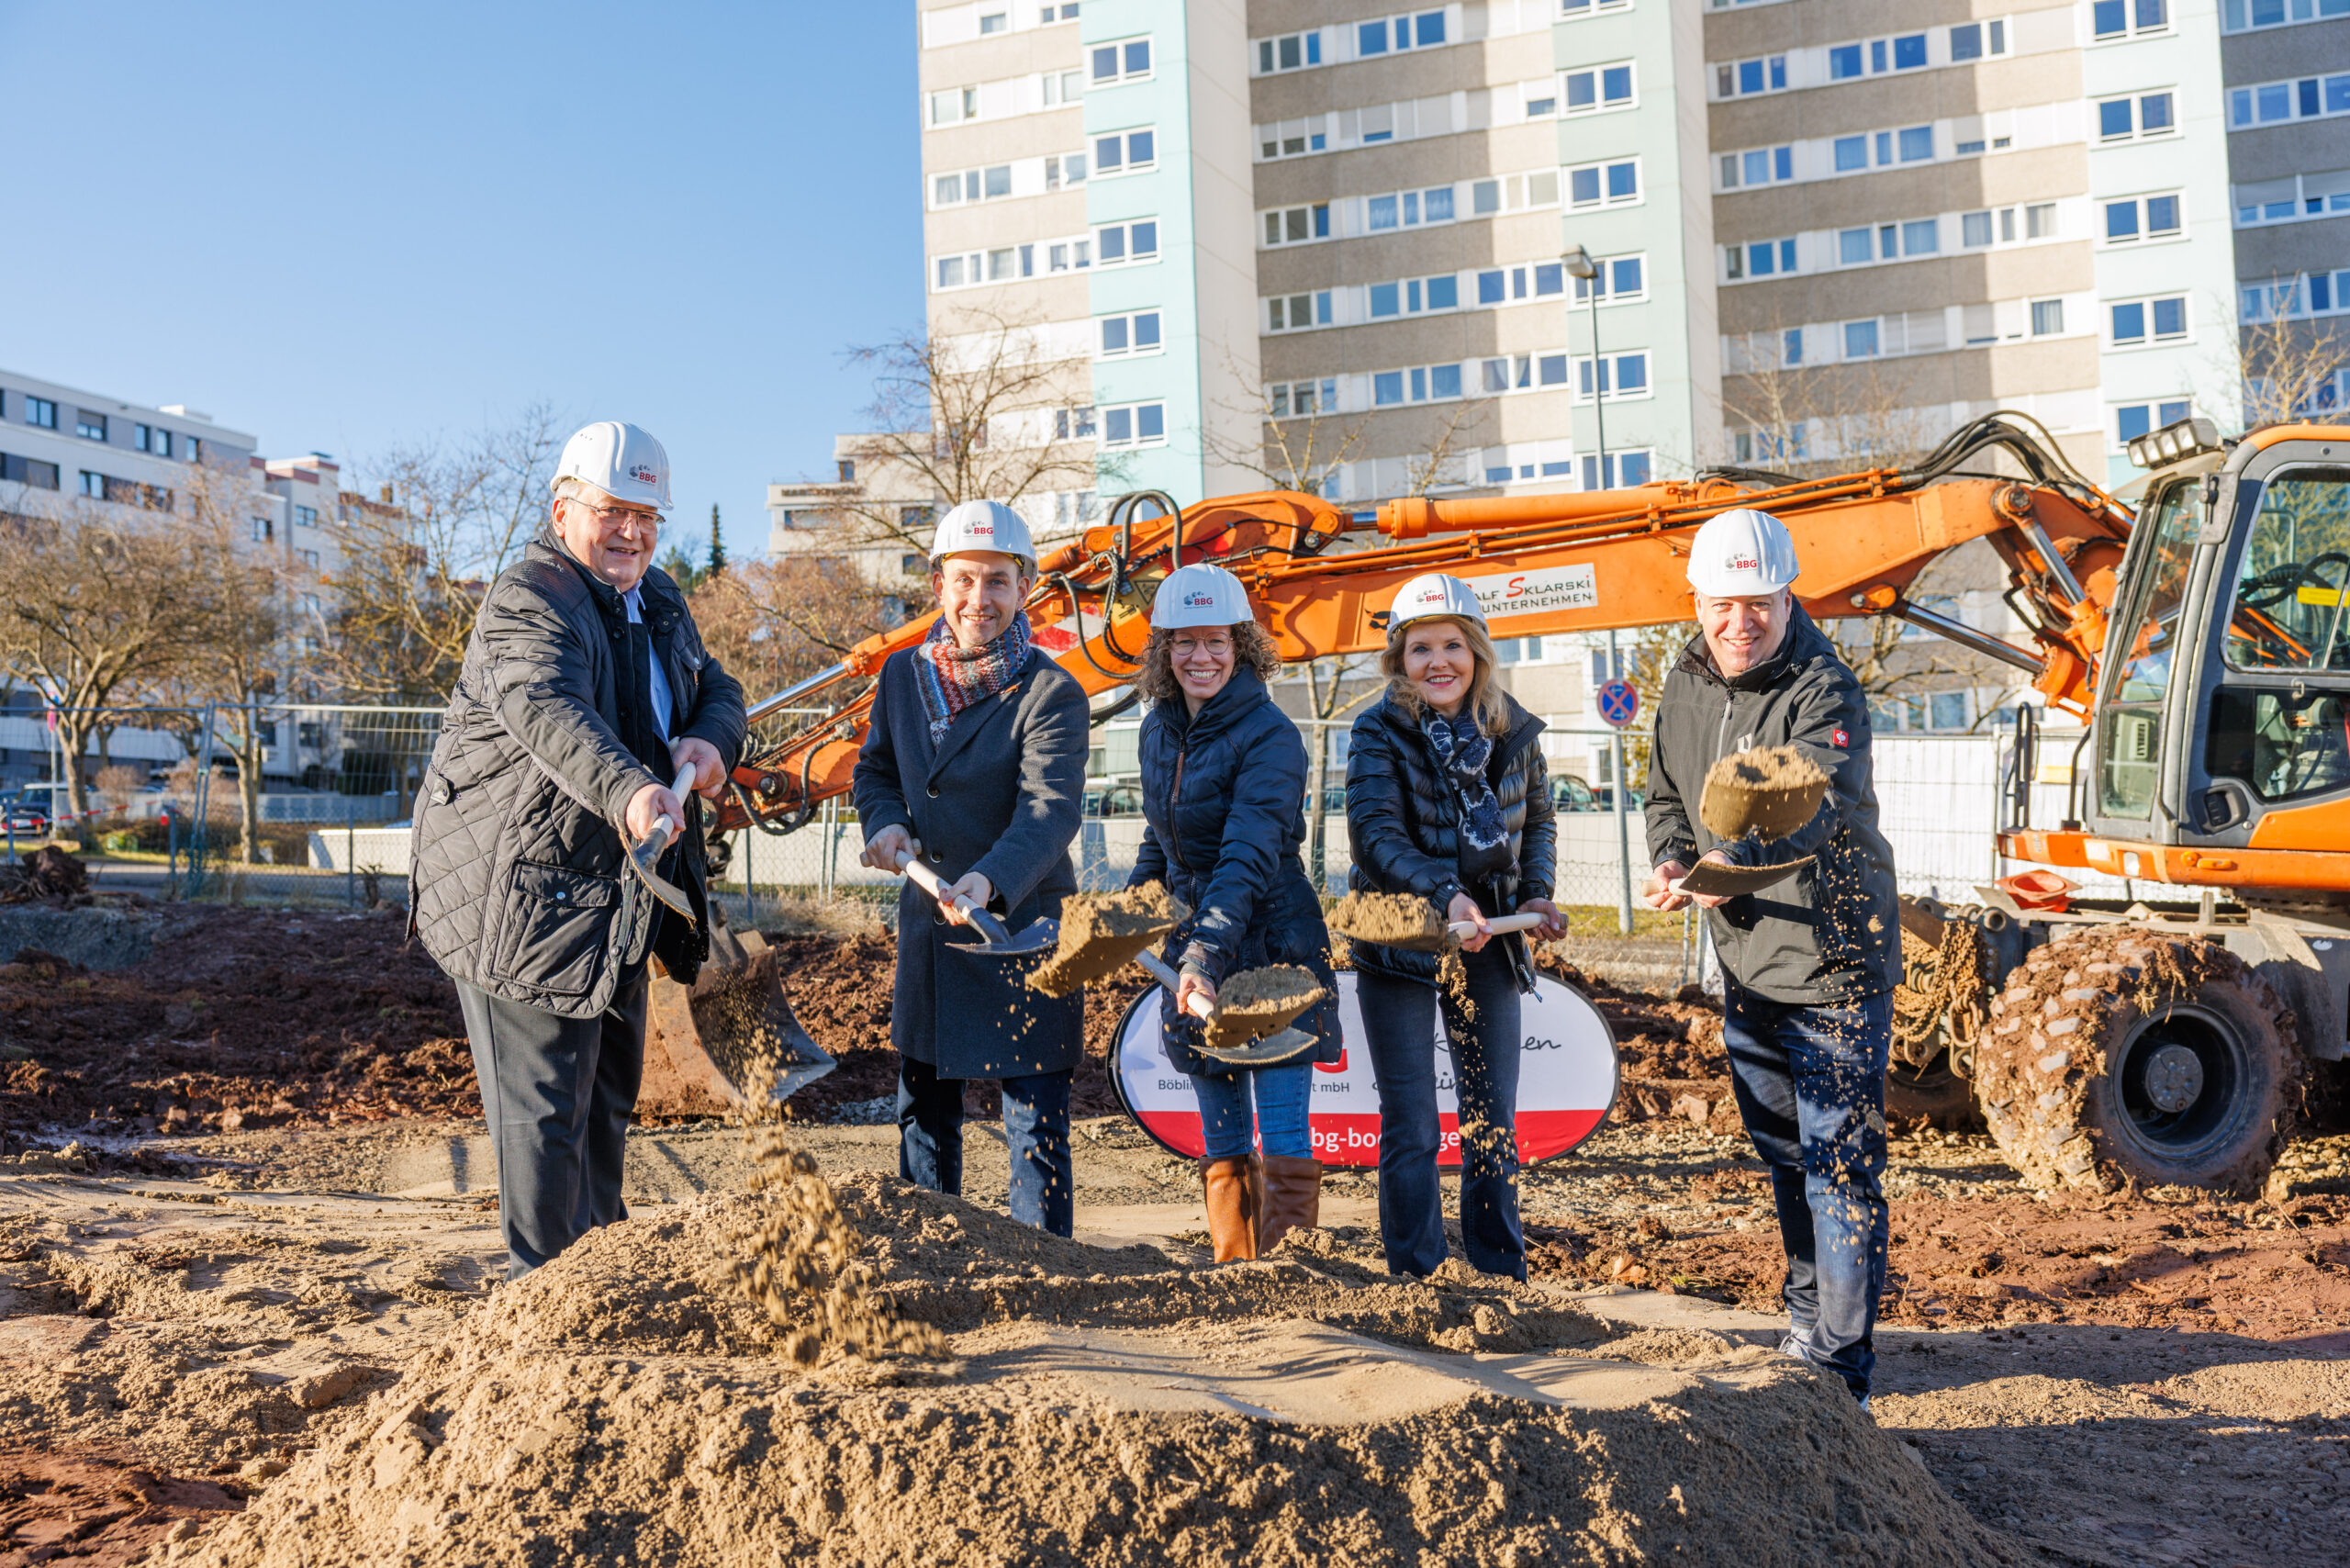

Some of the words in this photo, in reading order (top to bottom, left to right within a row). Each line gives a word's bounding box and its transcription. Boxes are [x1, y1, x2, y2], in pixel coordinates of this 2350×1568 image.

[639, 472, 657, 484] BBG
[1736, 559, 1758, 568] BBG
[1194, 597, 1214, 606] BBG
[1426, 594, 1445, 602] BBG
[1321, 1082, 1349, 1092] mbH
